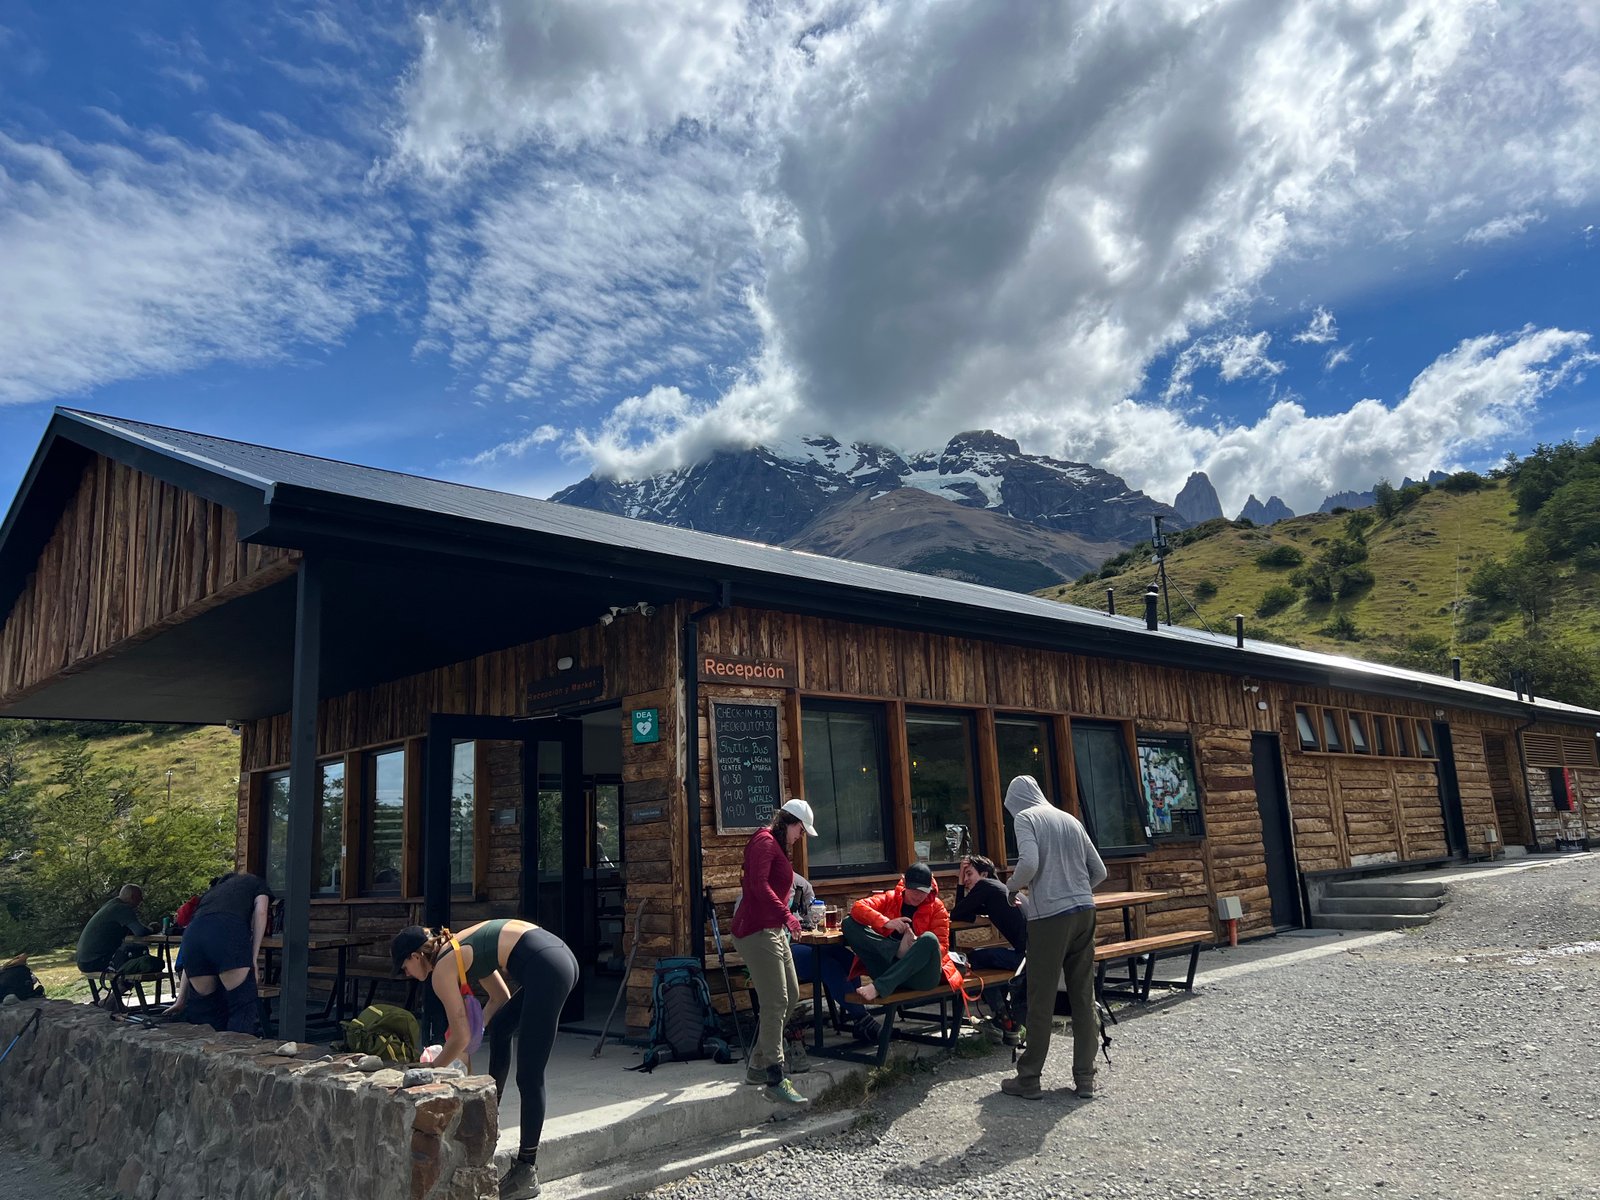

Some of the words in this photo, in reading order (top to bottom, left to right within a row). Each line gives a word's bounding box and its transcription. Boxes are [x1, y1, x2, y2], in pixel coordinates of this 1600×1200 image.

[705, 659, 784, 680] Recepción
[636, 711, 652, 719] DEA
[752, 742, 768, 755] Bus
[754, 775, 763, 783] TO
[747, 785, 770, 794] PUERTO
[748, 795, 773, 803] NATALES
